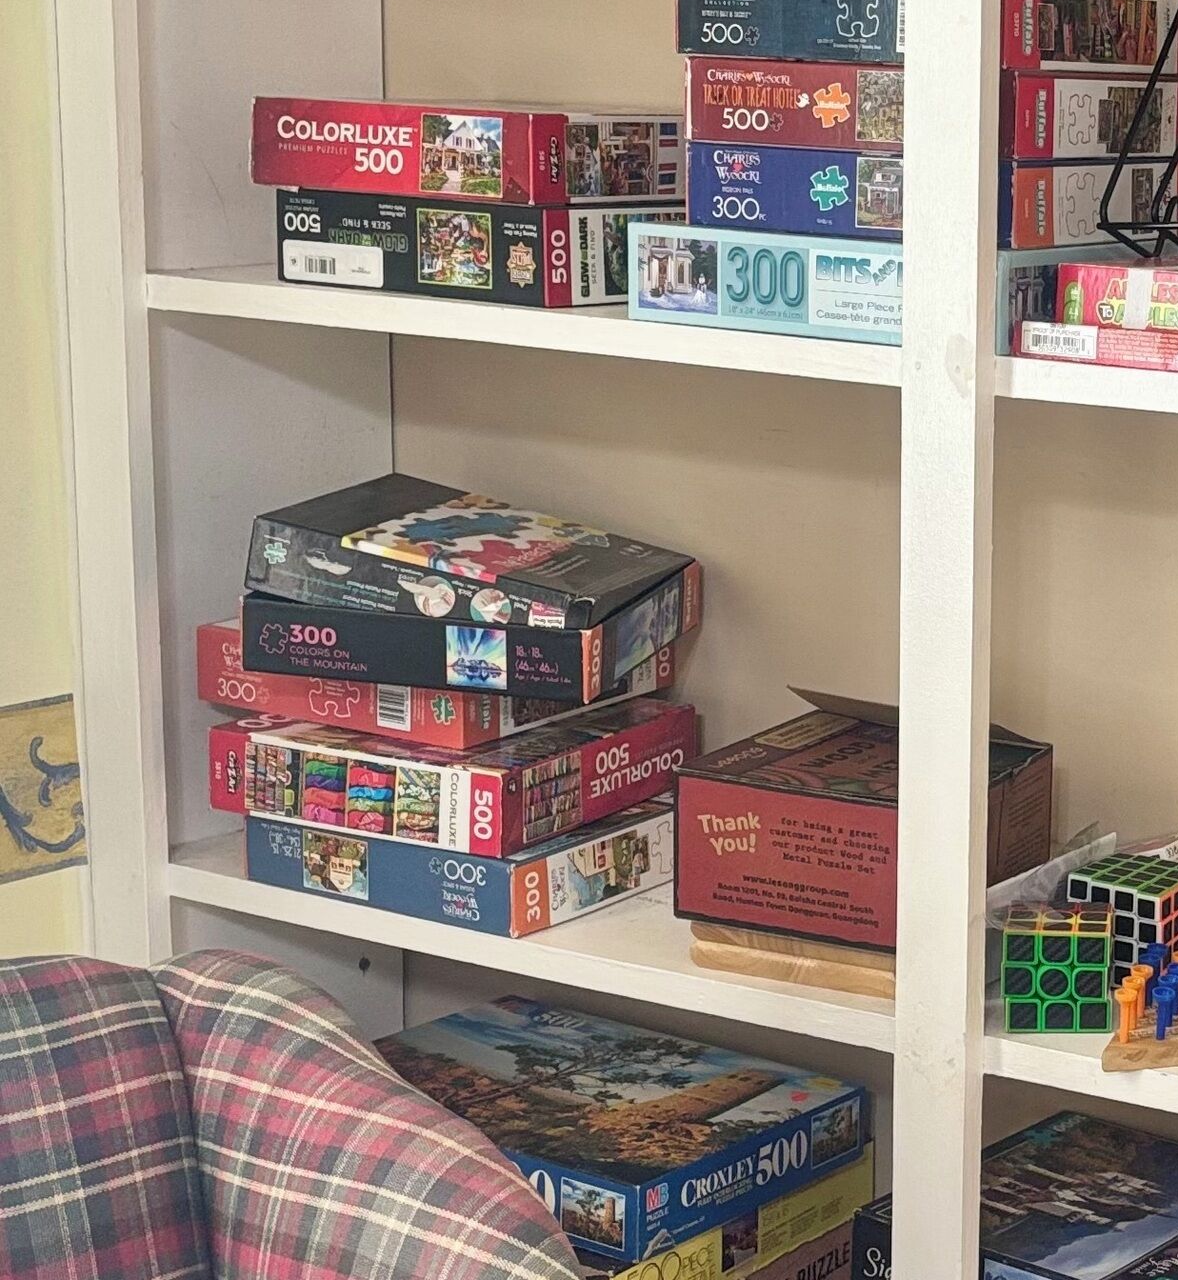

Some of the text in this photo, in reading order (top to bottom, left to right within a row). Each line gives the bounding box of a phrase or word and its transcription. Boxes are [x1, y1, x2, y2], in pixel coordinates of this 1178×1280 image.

[700, 22, 744, 44] 500
[703, 83, 771, 108] TRICK OR TREAT
[277, 115, 414, 148] COLORLUXE
[721, 107, 769, 131] 500
[278, 142, 349, 156] PREMIUM PUZZLES
[354, 147, 404, 175] 500
[712, 195, 760, 220] 300
[284, 211, 322, 234] 500
[550, 229, 567, 284] 500
[726, 246, 805, 308] 300
[815, 254, 898, 286] BITS AND
[835, 299, 895, 313] Large Piece
[289, 624, 337, 647] 300
[289, 646, 350, 660] COLORS ON
[289, 656, 368, 672] THE MOUNTAIN
[217, 677, 256, 703] 300
[595, 742, 631, 772] 500
[589, 748, 685, 800] COLORLUXE
[448, 772, 459, 848] COLORLUXE
[473, 790, 494, 841] 500
[697, 812, 762, 834] Thank
[781, 817, 879, 840] for being great
[709, 833, 757, 856] You!
[771, 840, 888, 865] our product Wood and
[820, 835, 838, 846] and
[442, 858, 488, 885] 300
[782, 852, 876, 876] Metal Puzzle Set
[524, 870, 541, 922] 300
[645, 1129, 808, 1213] MB CROXLEY 500
[646, 1206, 670, 1223] PUZZLE
